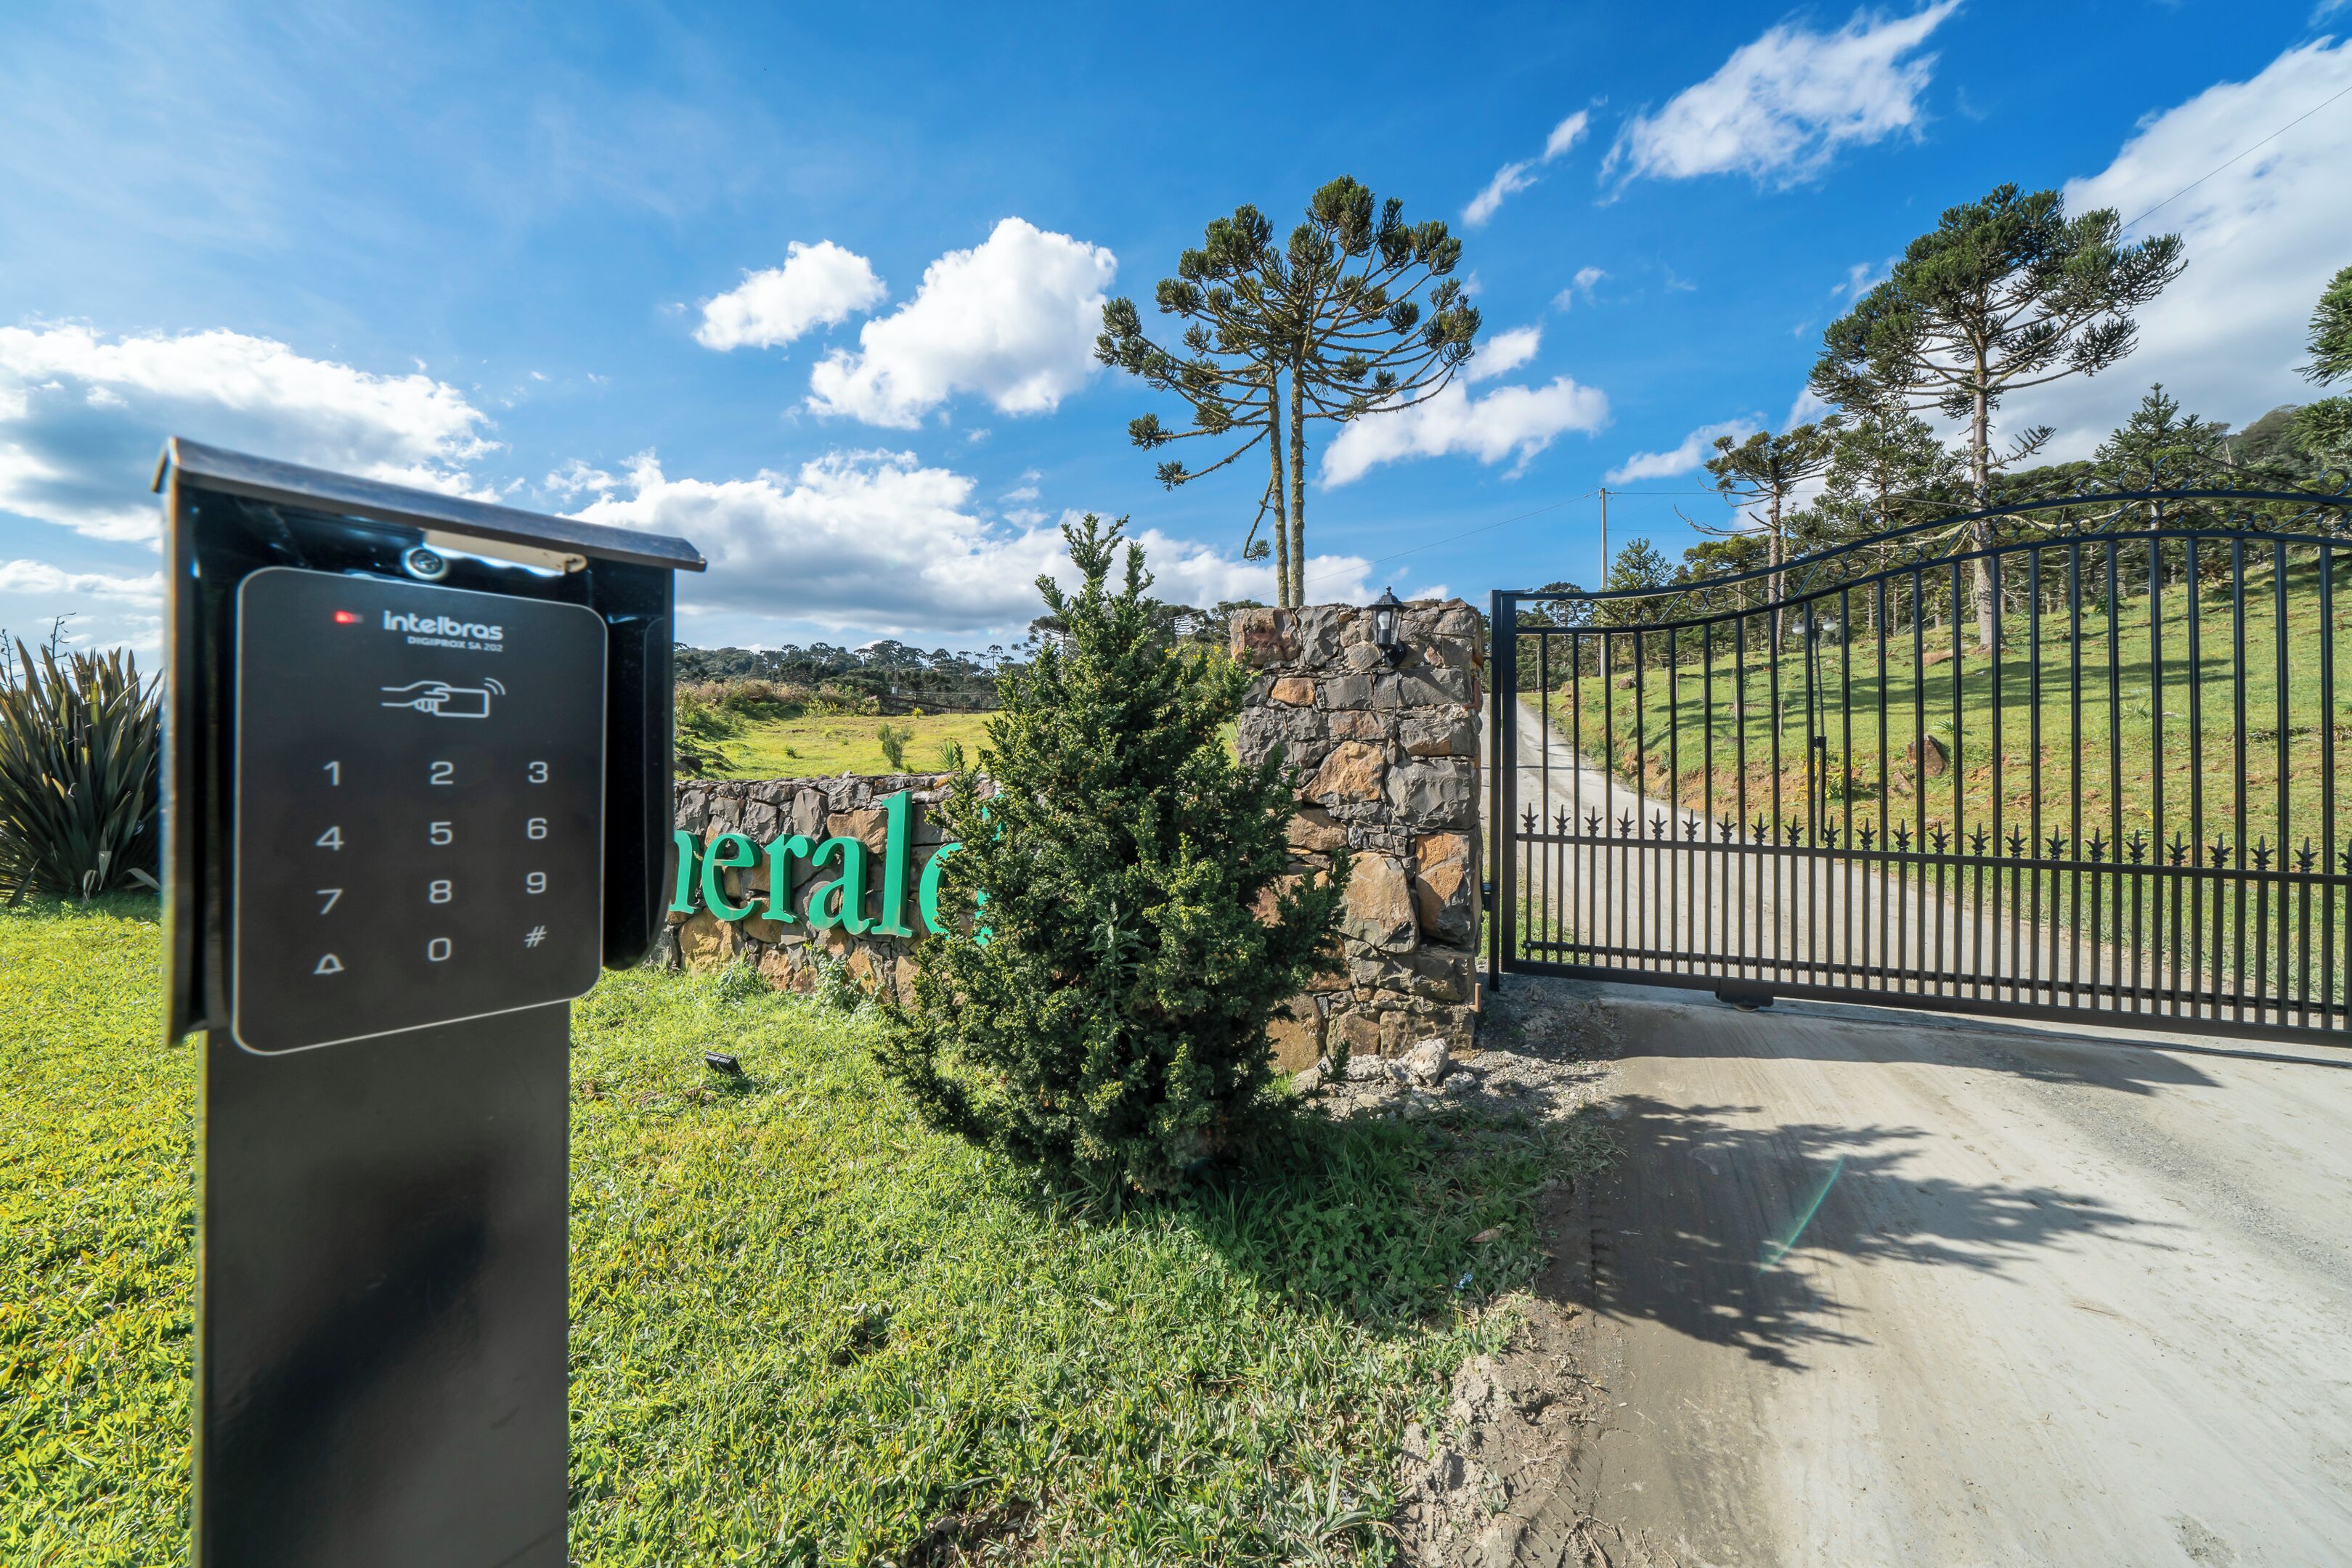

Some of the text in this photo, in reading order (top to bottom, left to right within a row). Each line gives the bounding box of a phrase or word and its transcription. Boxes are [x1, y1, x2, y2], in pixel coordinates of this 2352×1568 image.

[383, 610, 503, 640] intelbras
[407, 635, 503, 653] DIGIPROX SA 202
[325, 761, 548, 785] 1 2 3
[317, 818, 547, 850] 4 5 6
[317, 872, 546, 914] 7 8 9
[428, 926, 547, 961] 0 #
